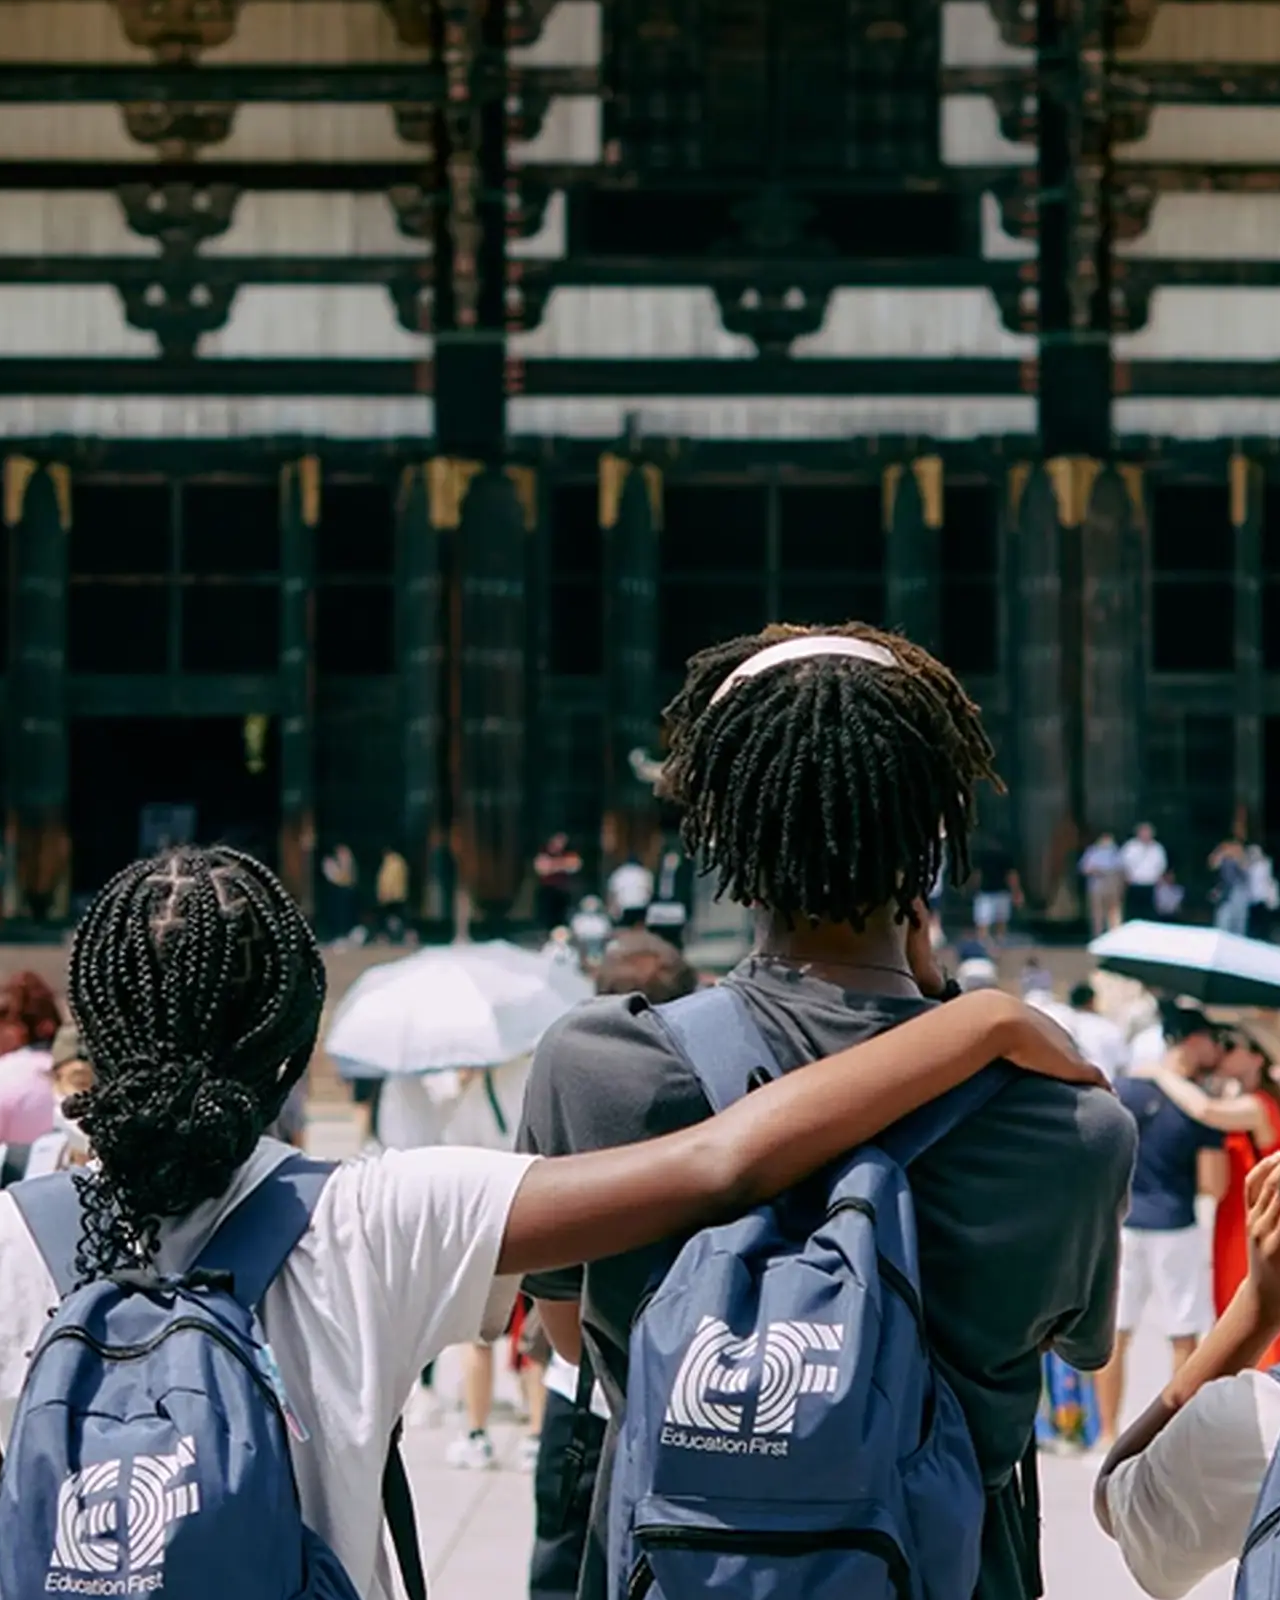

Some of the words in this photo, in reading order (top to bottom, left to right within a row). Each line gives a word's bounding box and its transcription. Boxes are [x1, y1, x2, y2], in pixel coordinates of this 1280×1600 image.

[665, 1315, 844, 1434] EF
[660, 1426, 747, 1454] Education
[749, 1437, 788, 1456] First
[50, 1435, 200, 1573] EF
[44, 1572, 125, 1596] Education
[127, 1571, 164, 1595] First
